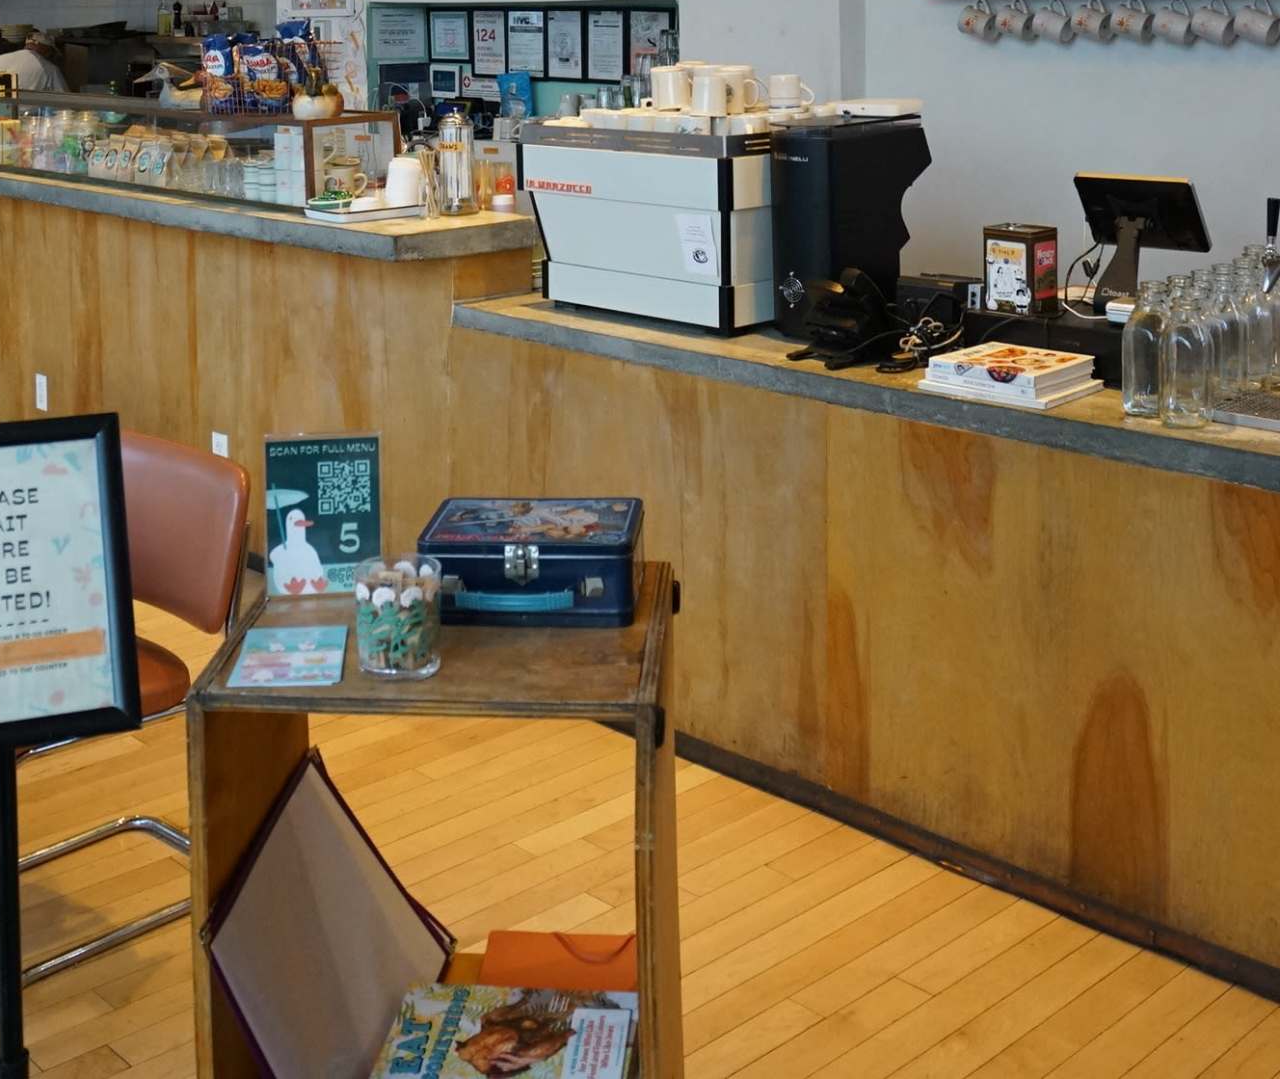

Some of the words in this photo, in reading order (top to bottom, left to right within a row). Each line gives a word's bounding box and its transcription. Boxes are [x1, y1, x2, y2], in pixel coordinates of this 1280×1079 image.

[476, 29, 496, 42] 124
[269, 446, 297, 457] SCAN
[300, 445, 319, 456] FOR
[322, 444, 345, 454] FULL
[347, 442, 376, 453] MENU
[339, 522, 360, 554] 5
[6, 566, 32, 585] BE
[389, 1016, 432, 1075] EAT
